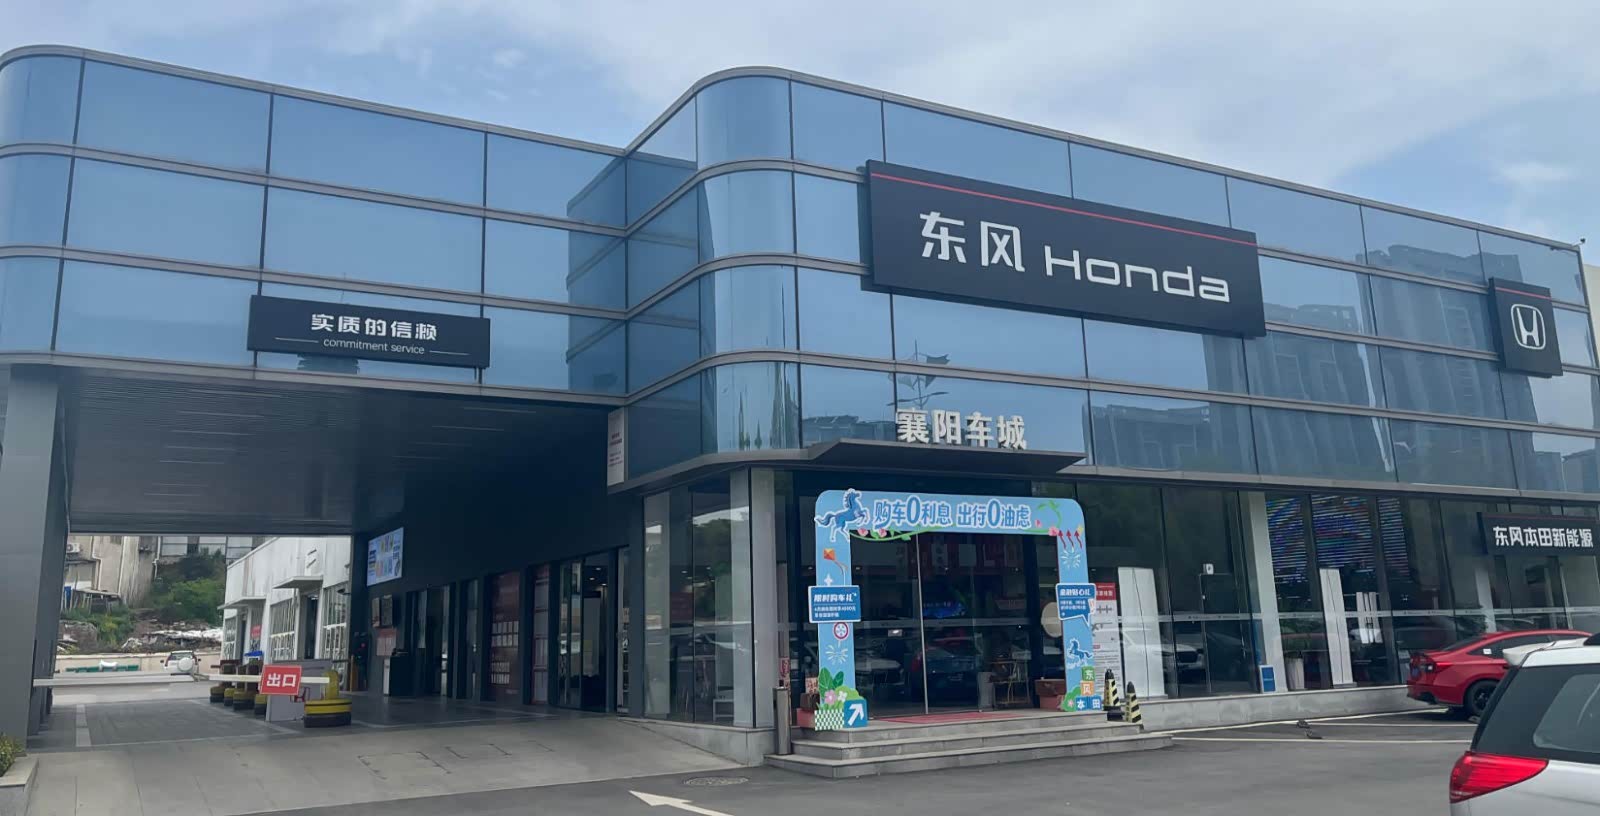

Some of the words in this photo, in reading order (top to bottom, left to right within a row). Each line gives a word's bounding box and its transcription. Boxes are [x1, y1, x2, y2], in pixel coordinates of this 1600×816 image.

[919, 211, 1025, 272] 东风
[1044, 245, 1230, 303] Honda
[311, 313, 438, 341] 实质的信赖
[323, 337, 389, 352] commitment
[390, 343, 425, 355] service
[896, 407, 1027, 450] 襄阳车城
[874, 496, 952, 529] 购车0利息
[957, 499, 1031, 528] 出行0油虑
[1493, 526, 1594, 548] 东风本田新能源
[266, 672, 297, 688] 出口
